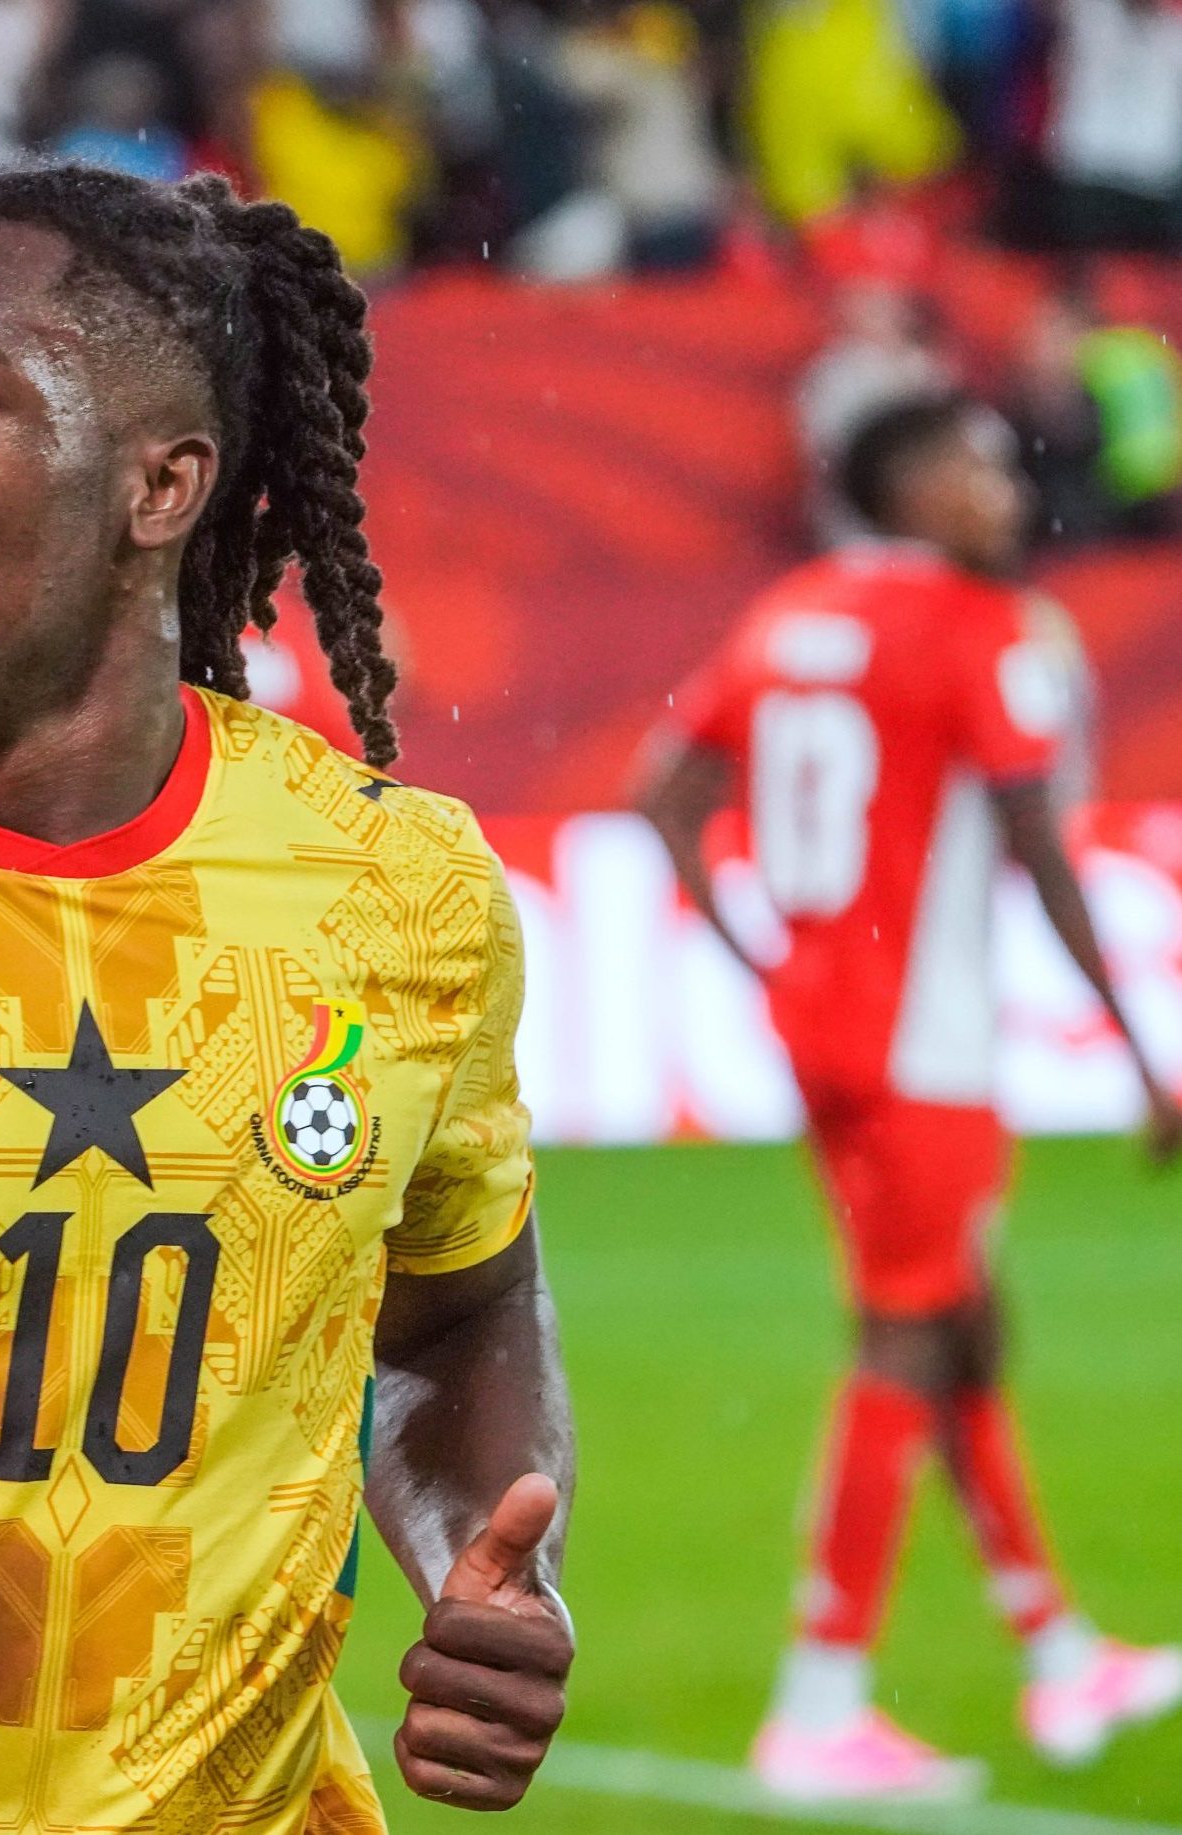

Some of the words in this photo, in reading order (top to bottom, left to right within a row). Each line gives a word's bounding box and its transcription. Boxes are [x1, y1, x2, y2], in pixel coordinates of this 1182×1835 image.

[250, 1113, 274, 1168] GHANA
[270, 1164, 334, 1201] FOOTBALL
[337, 1116, 382, 1197] ASSOCIATION
